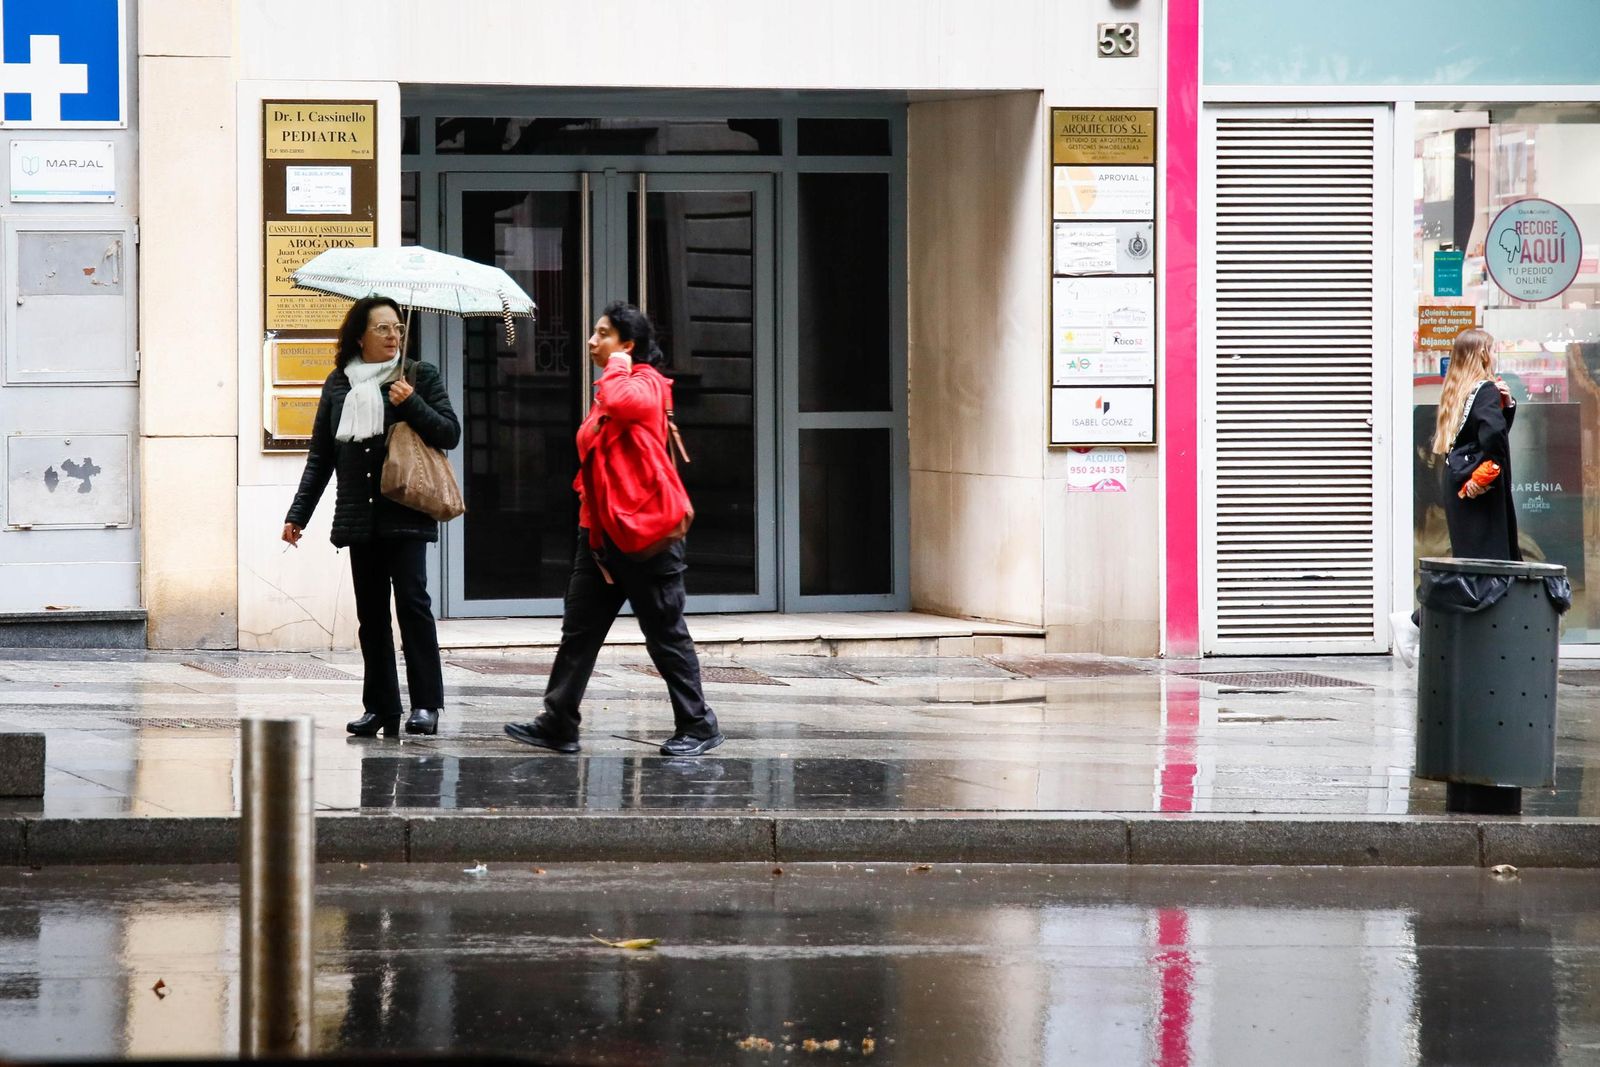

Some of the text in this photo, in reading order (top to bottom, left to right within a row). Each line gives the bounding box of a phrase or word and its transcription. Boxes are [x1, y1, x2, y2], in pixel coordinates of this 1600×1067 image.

[1100, 23, 1135, 54] 53
[274, 111, 366, 123] Dr. I. Cassinello
[1062, 124, 1128, 134] ARQUITECTOS
[282, 130, 358, 142] PEDIATRA
[46, 159, 104, 168] MARJAL
[1098, 174, 1139, 182] APROVIAL
[315, 225, 354, 234] CASSINELLO
[1515, 220, 1558, 235] RECOGE
[287, 239, 355, 248] ABOGADOS
[1519, 231, 1566, 264] AQUÍ
[1508, 267, 1553, 275] TU PEDIDO
[1515, 276, 1547, 284] ONLINE
[1420, 318, 1437, 326] parte
[1432, 326, 1459, 334] equipo?
[1420, 337, 1453, 346] Déjanos
[1071, 418, 1099, 426] ISABEL
[1085, 454, 1125, 463] ALQUILO
[1070, 466, 1126, 474] 950 244 357
